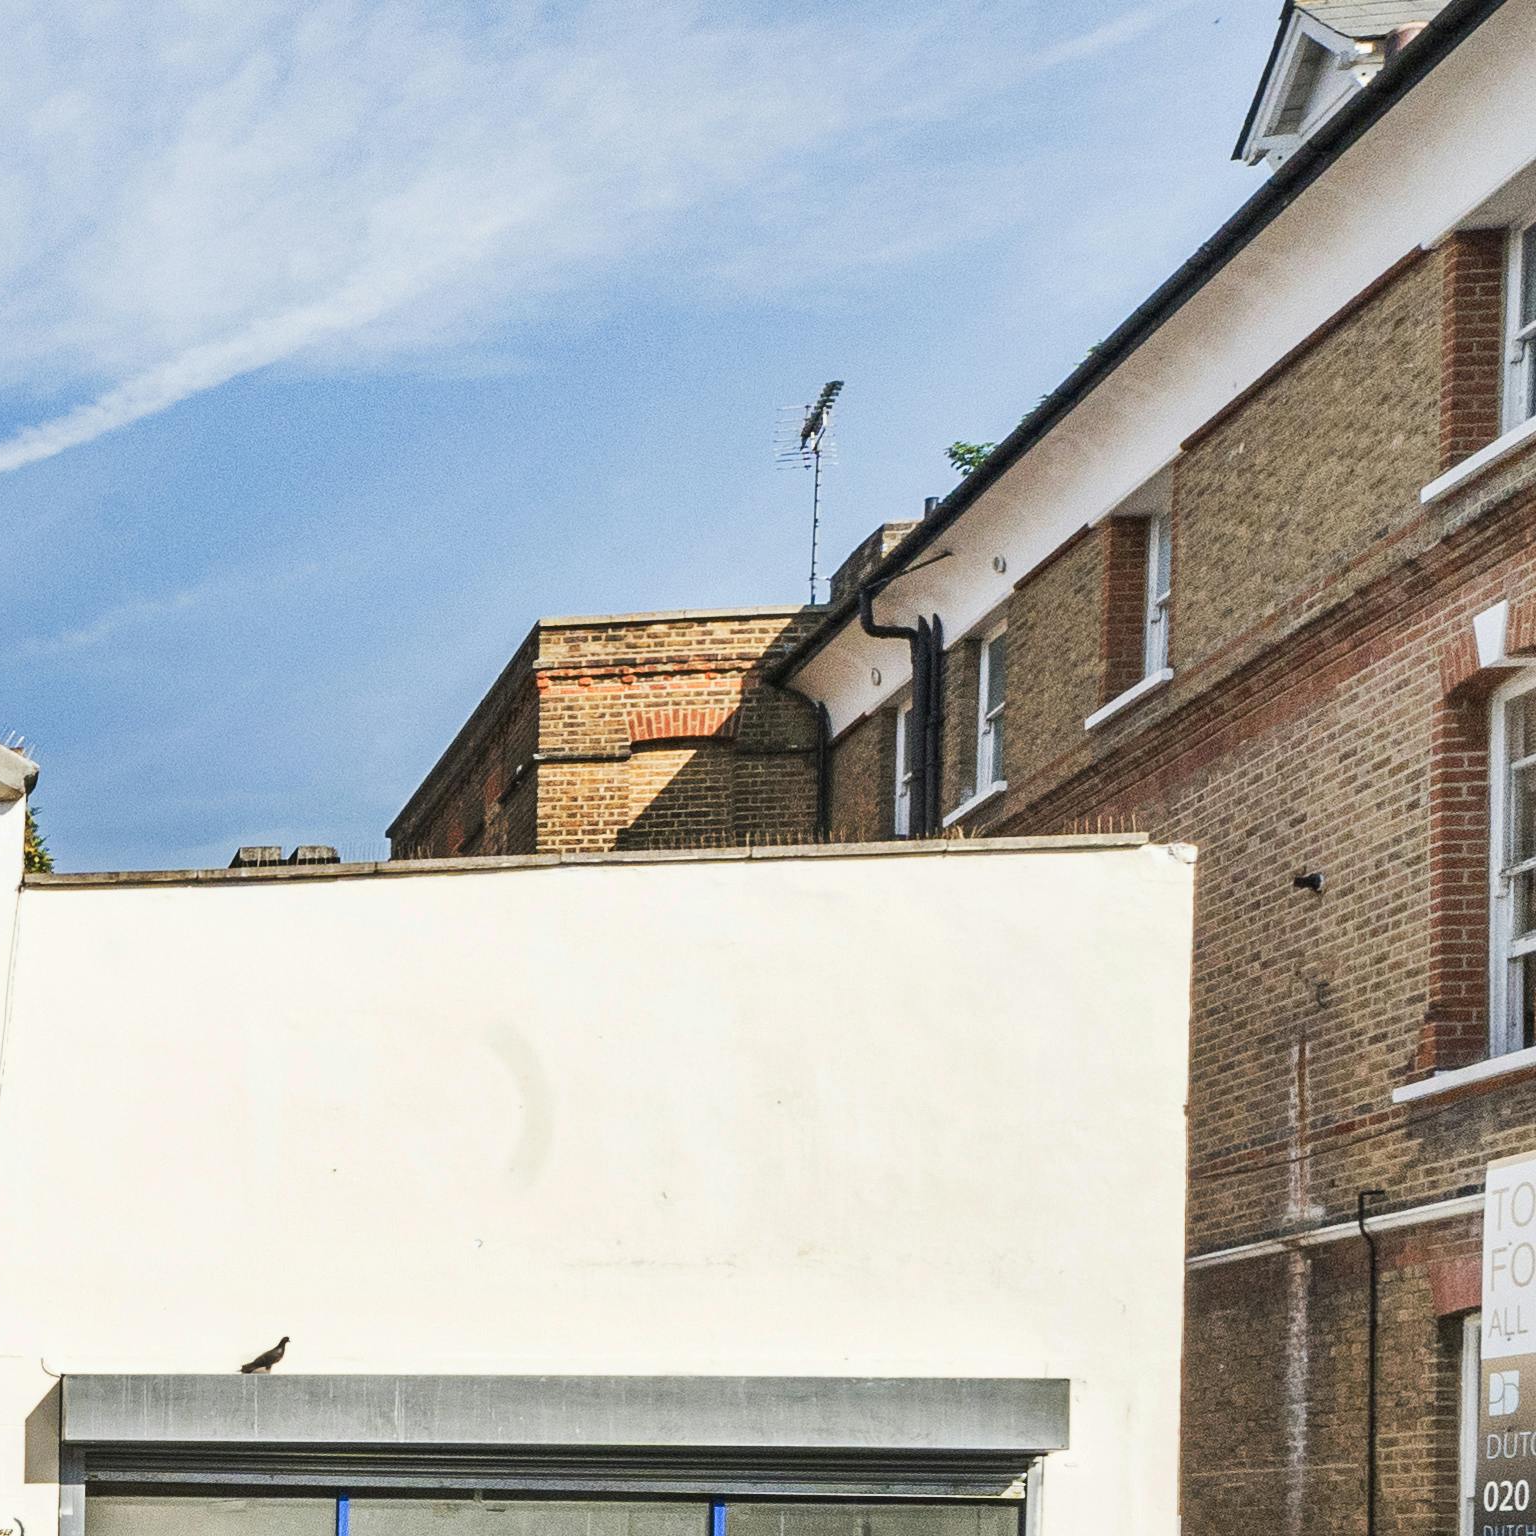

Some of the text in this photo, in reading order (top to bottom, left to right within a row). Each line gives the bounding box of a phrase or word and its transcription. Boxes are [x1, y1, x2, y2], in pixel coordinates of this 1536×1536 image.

[1492, 1181, 1536, 1232] TO
[1488, 1305, 1528, 1338] ALL
[1483, 1480, 1529, 1512] 020
